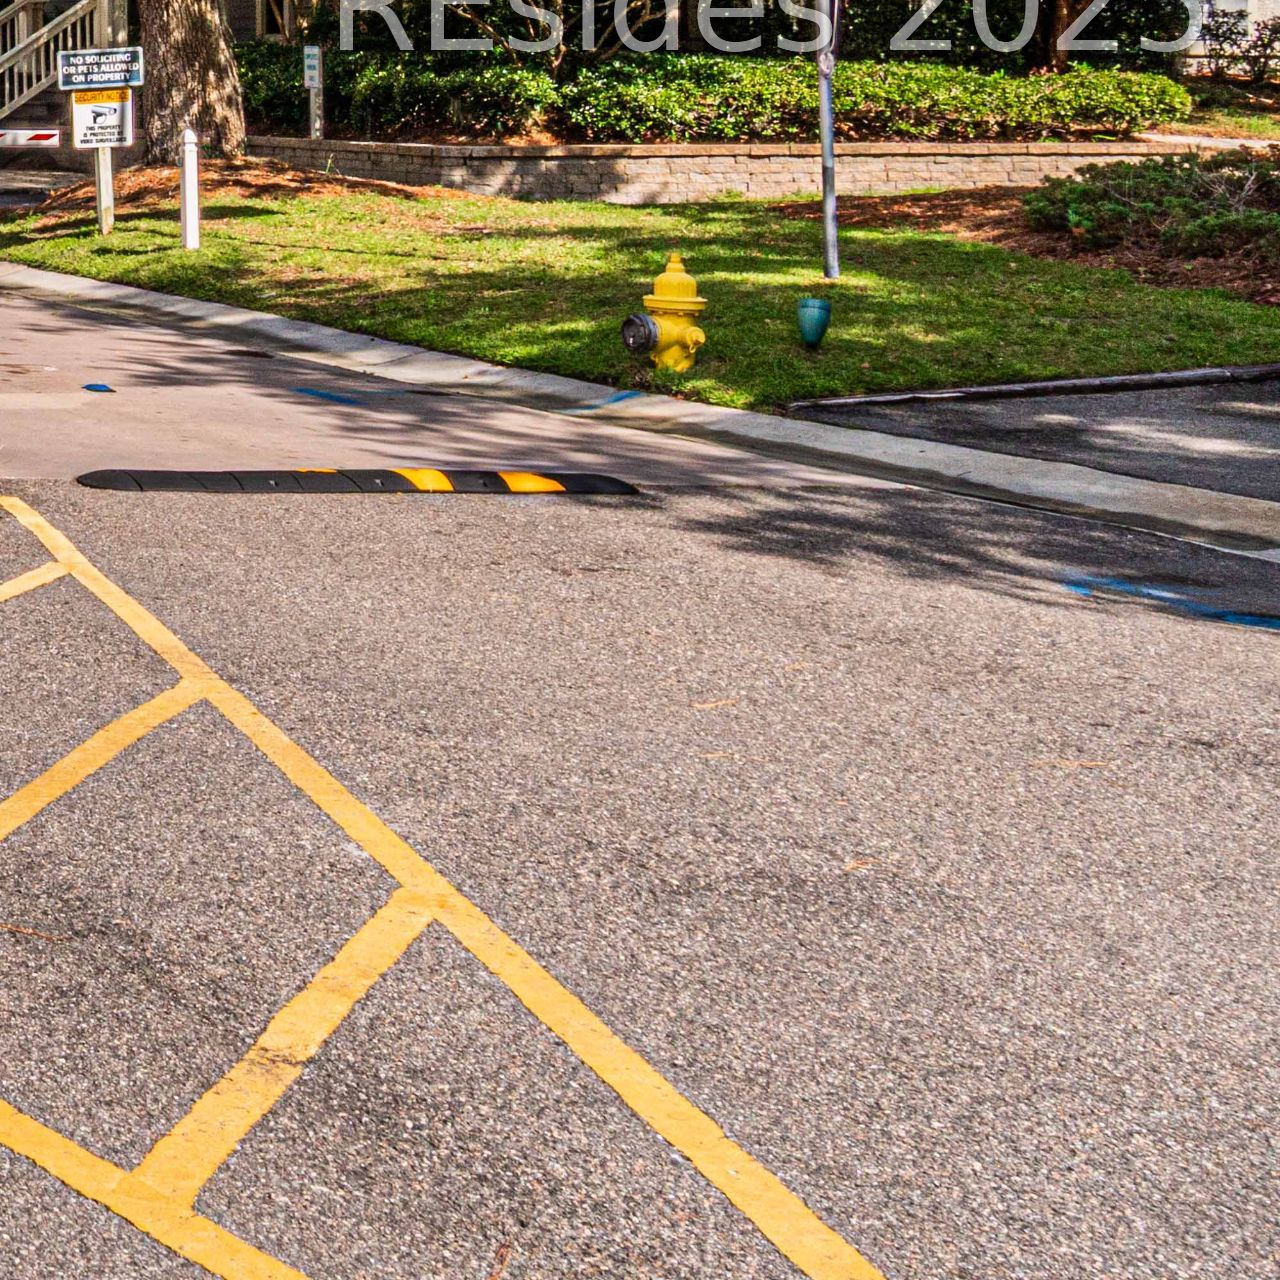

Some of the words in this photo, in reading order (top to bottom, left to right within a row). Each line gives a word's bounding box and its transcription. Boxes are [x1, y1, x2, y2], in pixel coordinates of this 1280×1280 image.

[70, 56, 83, 64] NO
[85, 53, 131, 64] SOLICITING
[63, 66, 76, 74] OR
[78, 64, 98, 73] PETS
[100, 63, 139, 72] ALLOWED
[87, 72, 130, 82] PROPERTY
